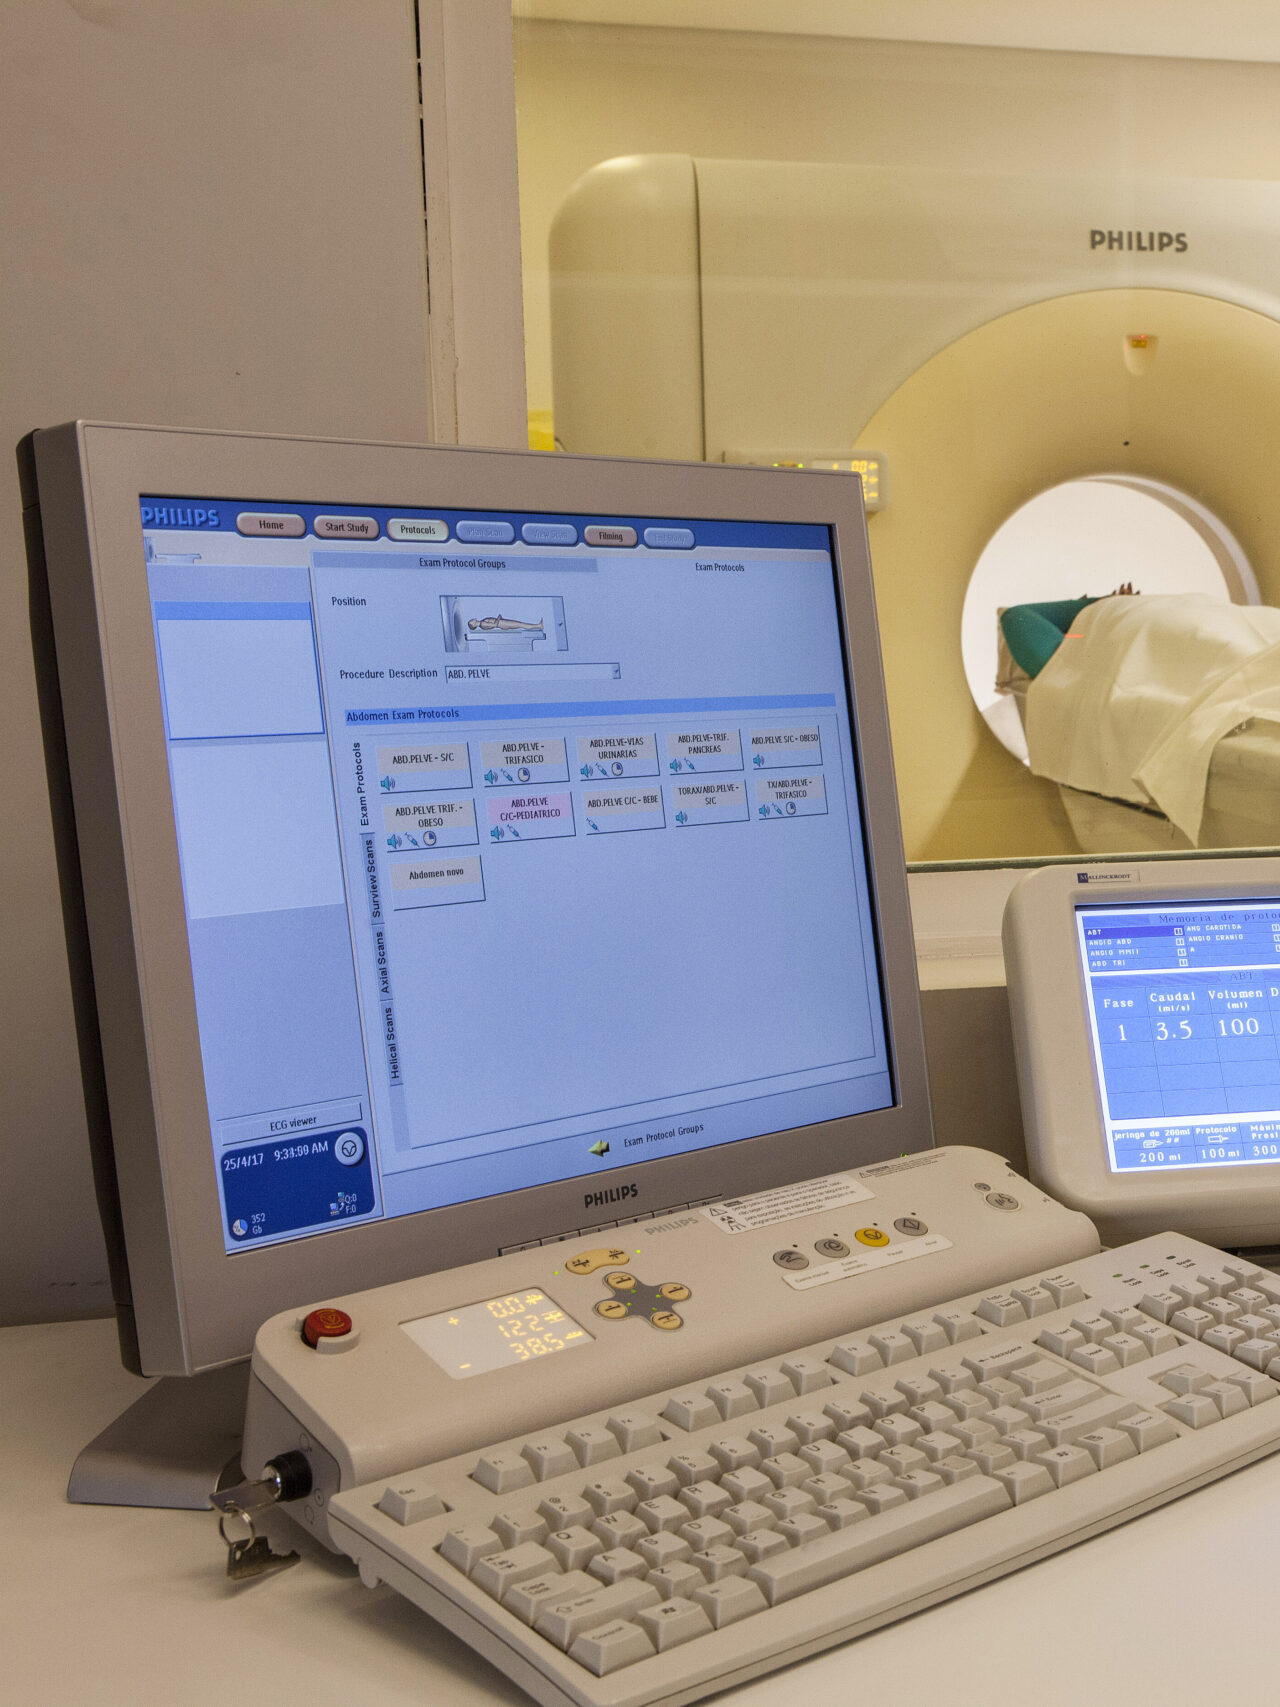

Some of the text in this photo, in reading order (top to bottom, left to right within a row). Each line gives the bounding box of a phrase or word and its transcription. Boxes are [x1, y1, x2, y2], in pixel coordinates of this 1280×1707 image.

[1090, 230, 1188, 252] PHILIPS
[141, 507, 219, 527] PHILIPS
[259, 520, 284, 530] Home
[326, 522, 369, 534] Start Study
[401, 525, 436, 535] Protocols
[599, 532, 623, 542] Filming
[419, 558, 506, 570] Exam Protocol Groups
[696, 563, 745, 572] Exam Protocols
[332, 596, 366, 606] Position
[340, 668, 490, 679] Procedure Description PELVE
[347, 709, 459, 721] Abdomen Exam Protocols
[752, 734, 818, 745] ABD.PELVE S/C OBESO
[502, 743, 538, 752] ABD.PELVE
[689, 745, 721, 754] PANCREAS
[393, 753, 454, 764] ABD.PELVE S/C
[505, 755, 544, 764] TRIFASICO
[599, 750, 637, 759] URINARIAS
[353, 742, 364, 793] Protocols
[776, 790, 807, 799] TRIFASICO
[511, 797, 548, 808] ABD.PELVE
[588, 795, 658, 808] ABD.PELVE BEBE
[705, 797, 716, 805] S/C
[395, 806, 433, 816] ABD.PELVE
[500, 809, 560, 821] C/C-PEDIATRICO
[418, 818, 443, 827] OBESO
[366, 840, 380, 917] Surview Scans
[409, 868, 464, 880] Abdomen novo
[1159, 913, 1213, 924] Memoria
[1221, 912, 1235, 921] de
[377, 931, 390, 994] Axial Scans
[1104, 998, 1133, 1008] Fase
[1150, 992, 1195, 1002] Caudal
[1209, 989, 1263, 999] Volumen
[1227, 1001, 1247, 1009] (ml)
[1118, 1024, 1126, 1041] 1
[1157, 1020, 1192, 1040] 3.5
[1219, 1018, 1259, 1036] 100
[385, 1008, 399, 1079] Helical Scans
[270, 1117, 317, 1131] ECG viewer
[1196, 1125, 1237, 1134] Protocolo
[624, 1124, 704, 1147] Exam Protocol Groups
[224, 1141, 328, 1171] 25/4/17 AM
[1202, 1148, 1225, 1159] 100
[1253, 1145, 1277, 1156] 300
[1140, 1151, 1164, 1162] 200
[584, 1184, 638, 1208] PHILIPS
[252, 1213, 265, 1224] 352
[252, 1226, 262, 1235] Gb
[499, 1315, 543, 1337] 122
